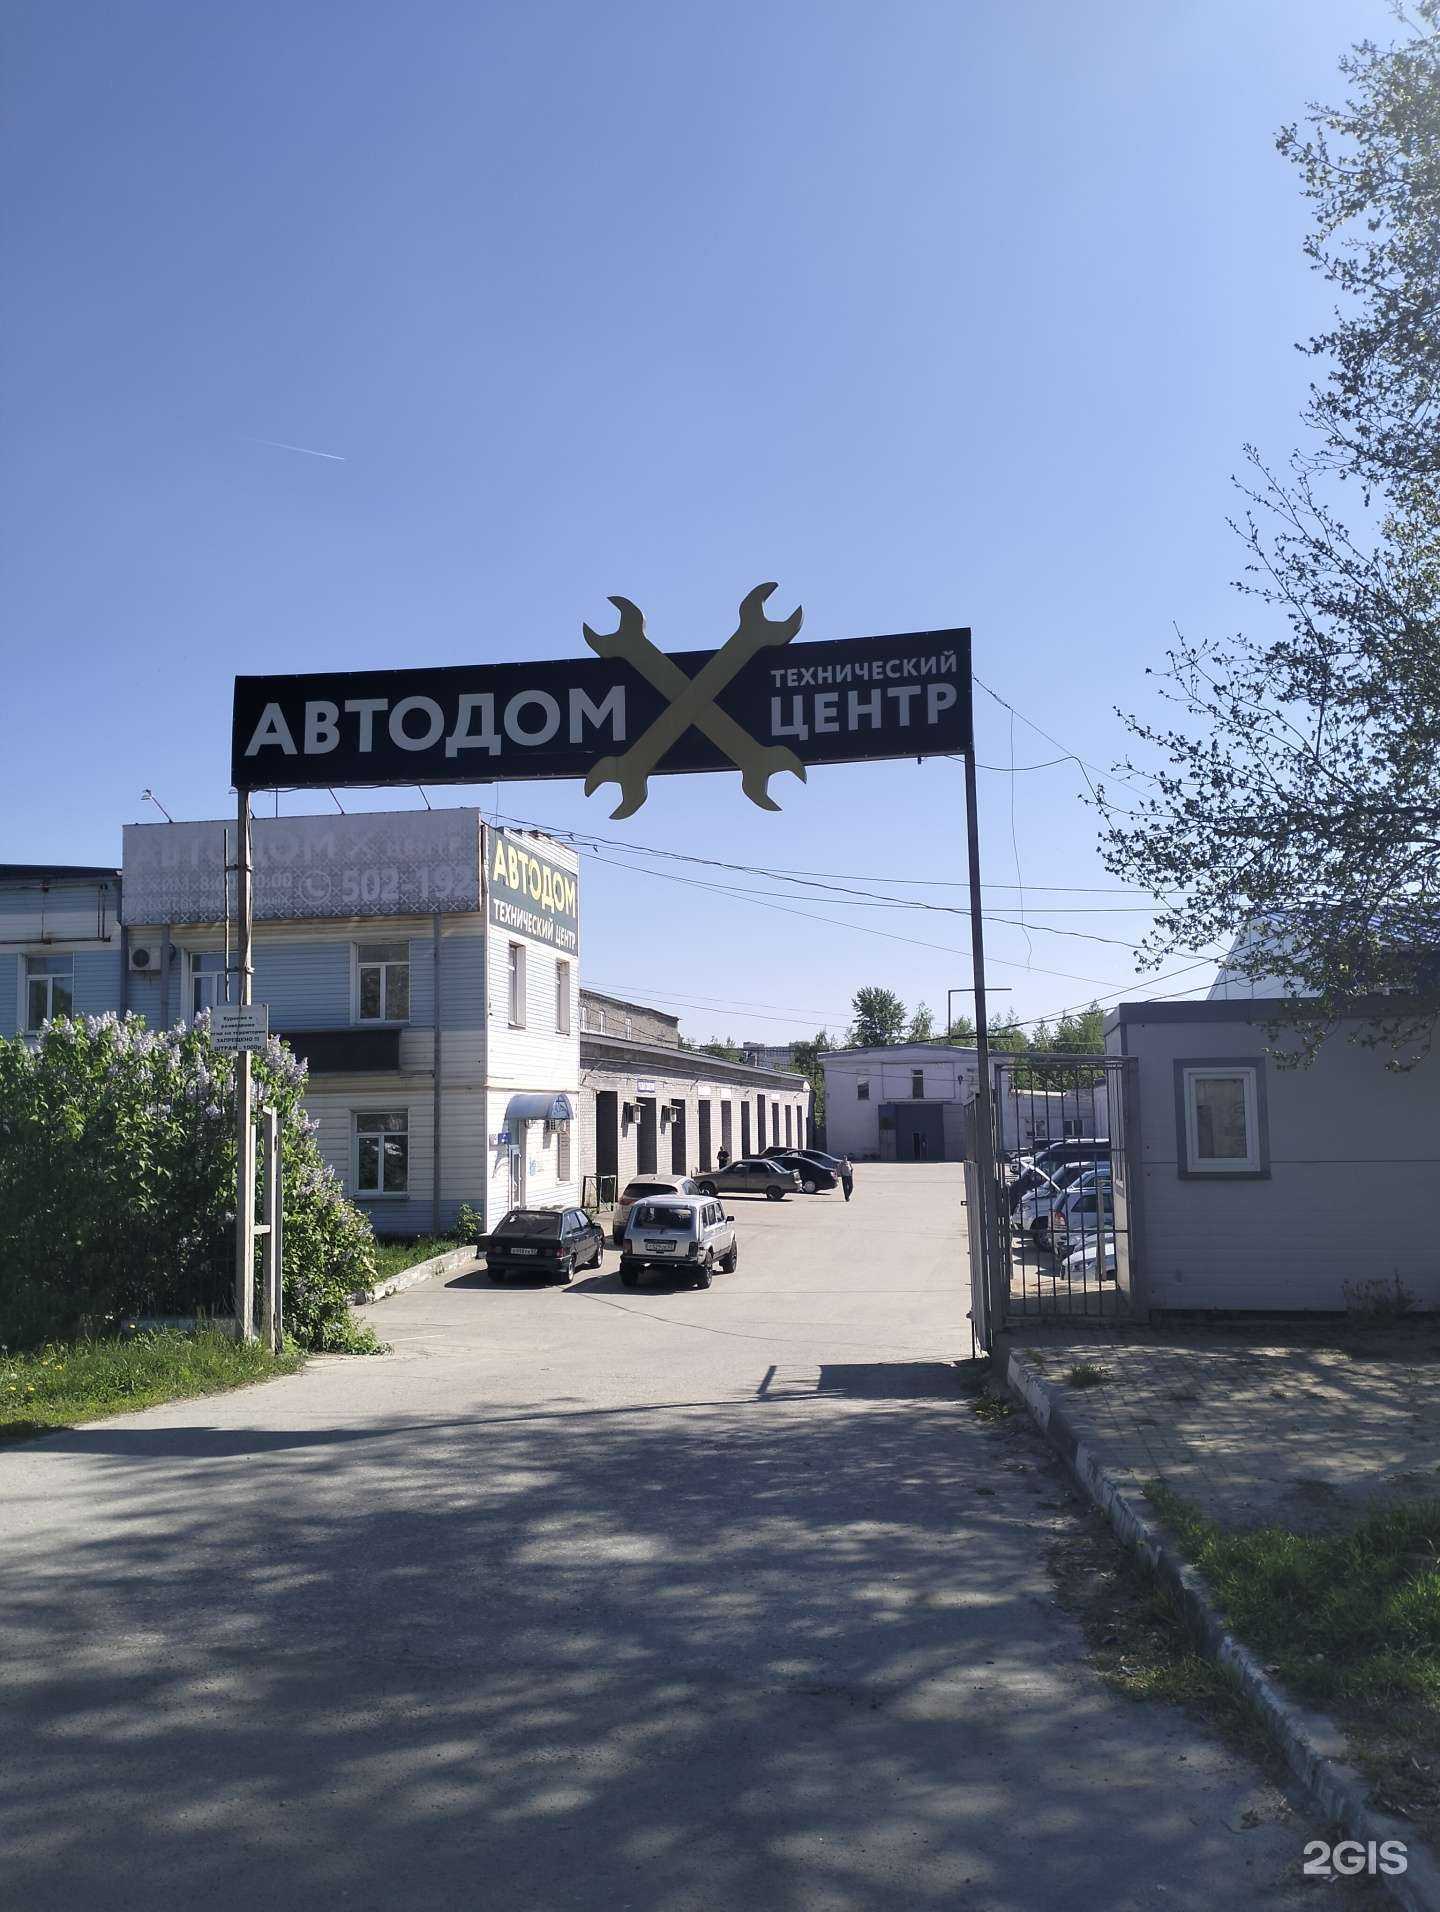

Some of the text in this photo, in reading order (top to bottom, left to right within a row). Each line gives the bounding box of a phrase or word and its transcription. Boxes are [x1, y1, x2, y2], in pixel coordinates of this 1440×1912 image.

[770, 650, 957, 688] ТЕХНИЧЕСКИЙ
[244, 685, 627, 758] АВТОДОМ
[771, 683, 958, 741] ЦЕНТР
[342, 865, 473, 900] 502-192
[493, 840, 576, 918] АВТОДОМ
[493, 898, 576, 950] ТЕХНИЧЕСКИЙ ЦЕНТР
